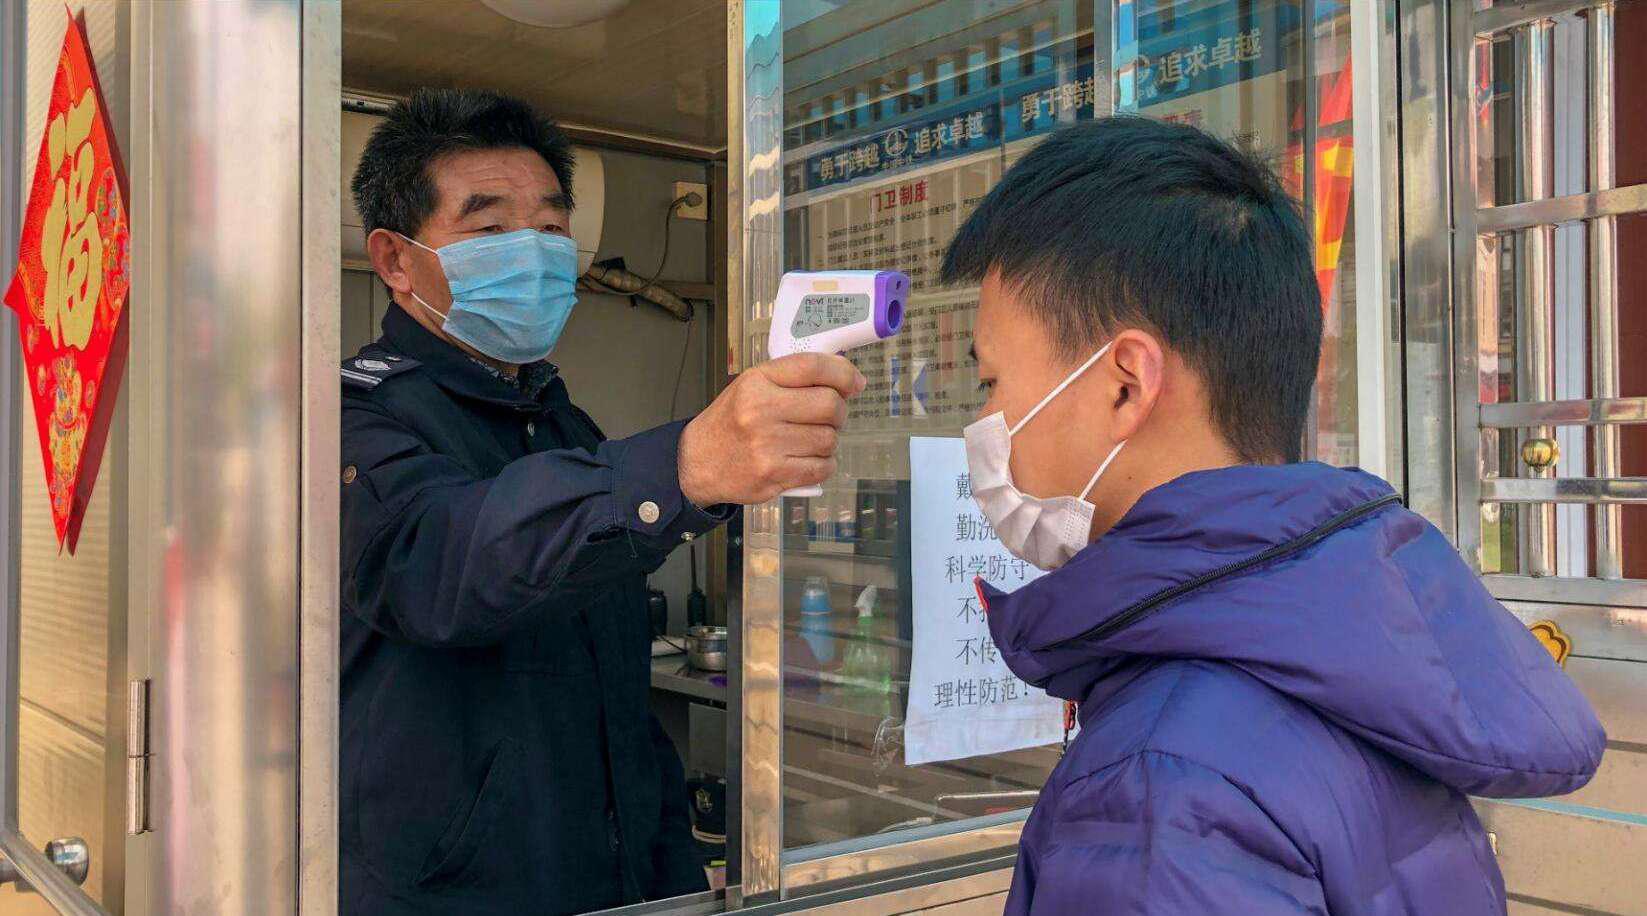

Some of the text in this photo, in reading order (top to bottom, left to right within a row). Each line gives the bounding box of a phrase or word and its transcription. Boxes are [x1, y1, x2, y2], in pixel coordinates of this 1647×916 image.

[1158, 29, 1262, 84] 追求卓越
[913, 111, 984, 154] 追求卓越
[873, 180, 928, 212] 门卫制度
[41, 87, 102, 351] 福
[956, 596, 986, 624] 不
